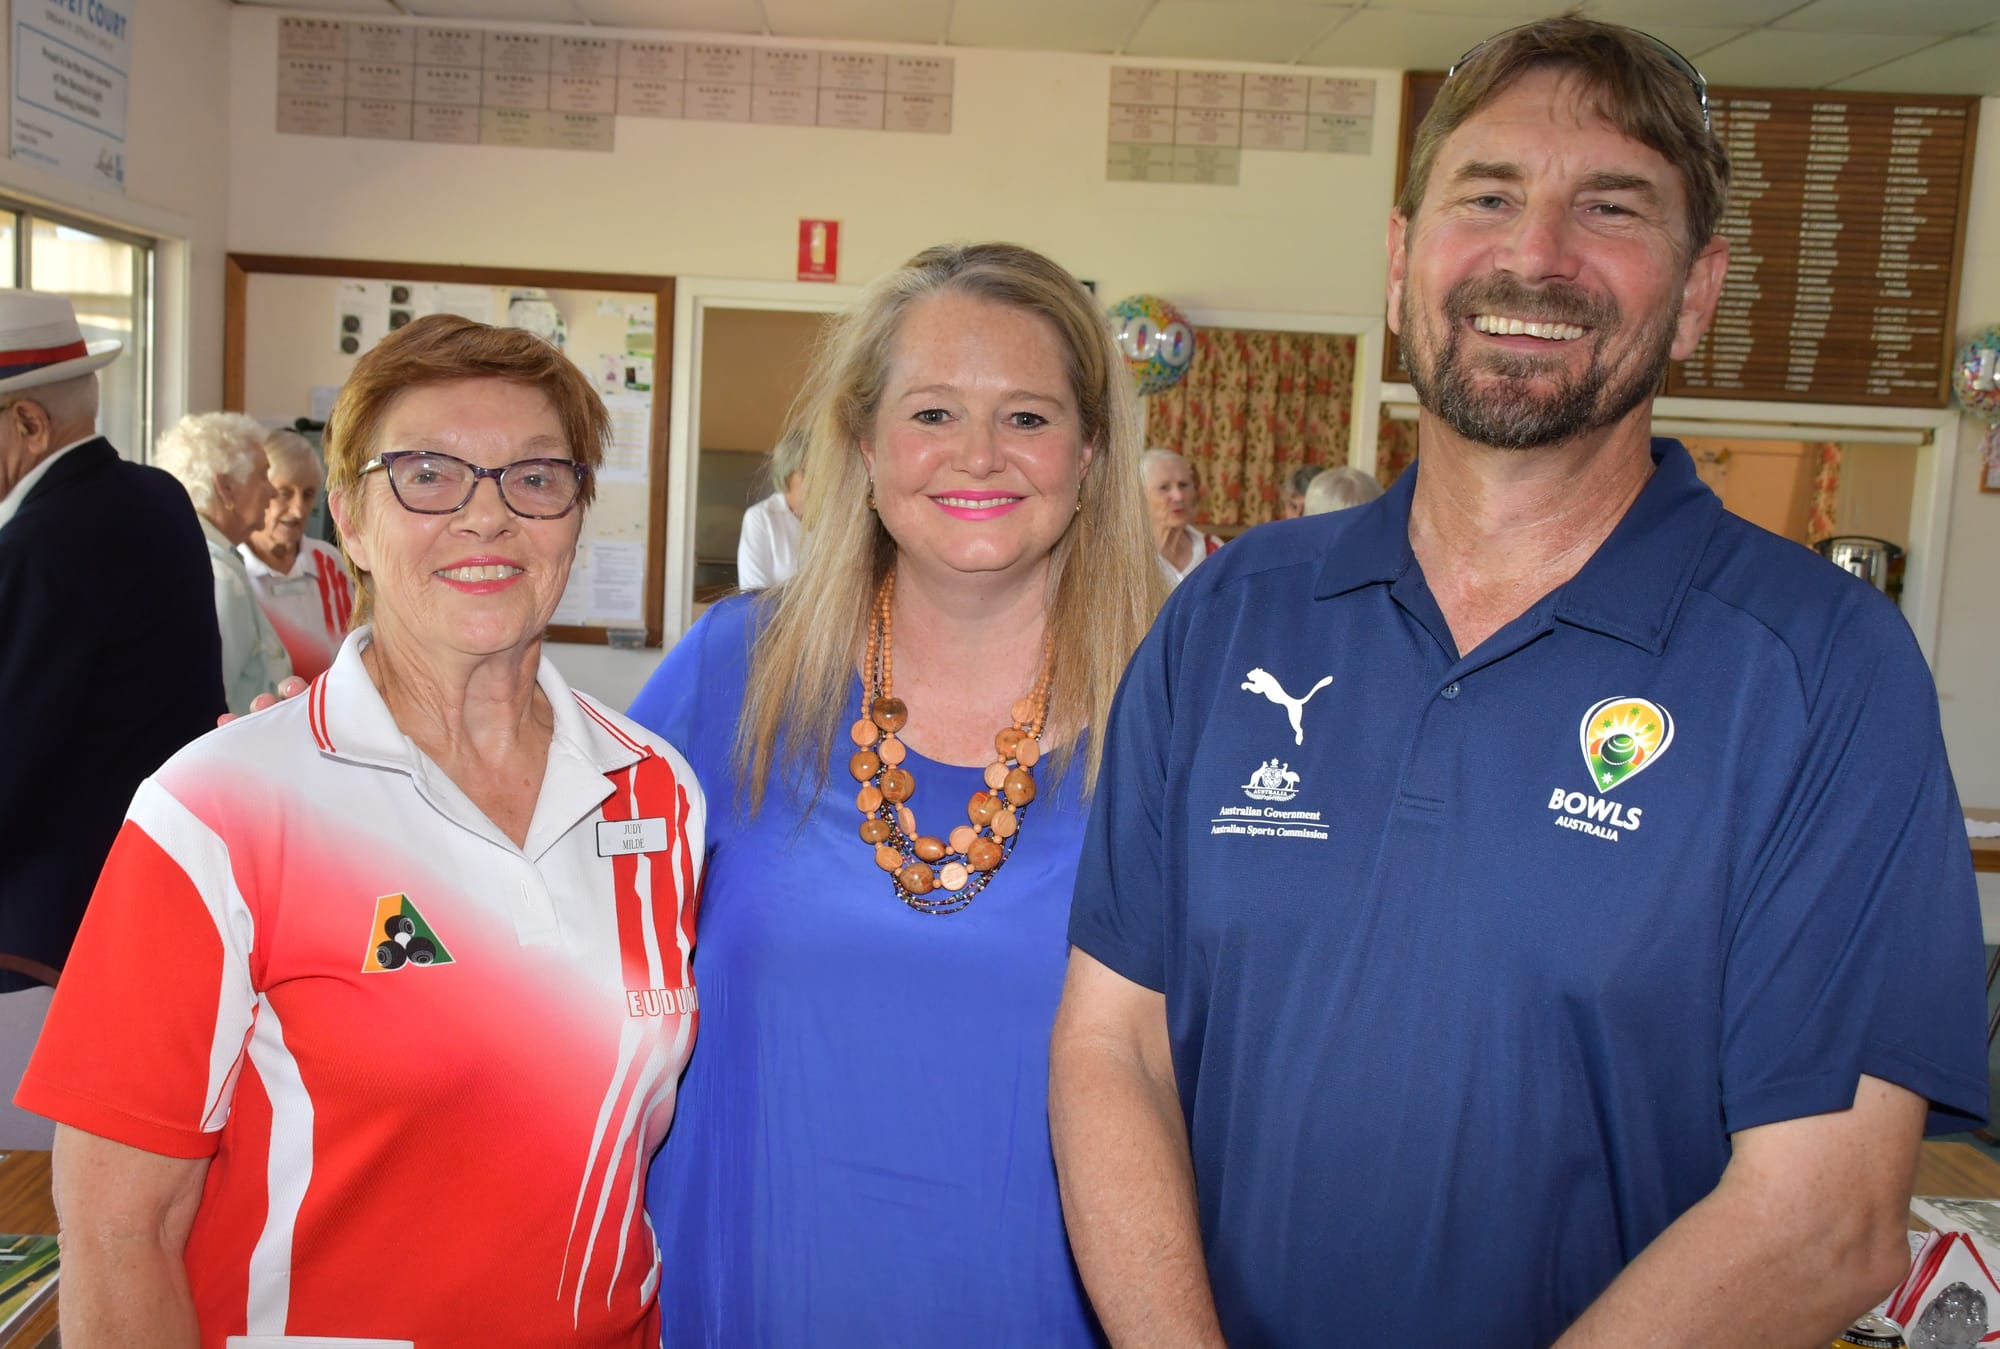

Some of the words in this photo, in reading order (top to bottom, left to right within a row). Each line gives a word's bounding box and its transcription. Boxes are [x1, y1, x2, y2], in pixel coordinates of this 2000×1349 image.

[86, 0, 127, 42] COURT
[1219, 806, 1262, 817] Australian
[1263, 807, 1321, 821] Government
[1548, 788, 1643, 831] BOWLS
[623, 823, 643, 835] JUDY
[1211, 824, 1246, 835] Australian
[1247, 825, 1276, 837] Sports
[1276, 827, 1329, 840] Commission
[1554, 815, 1619, 842] AUSTRALIA
[622, 838, 646, 850] MILDE
